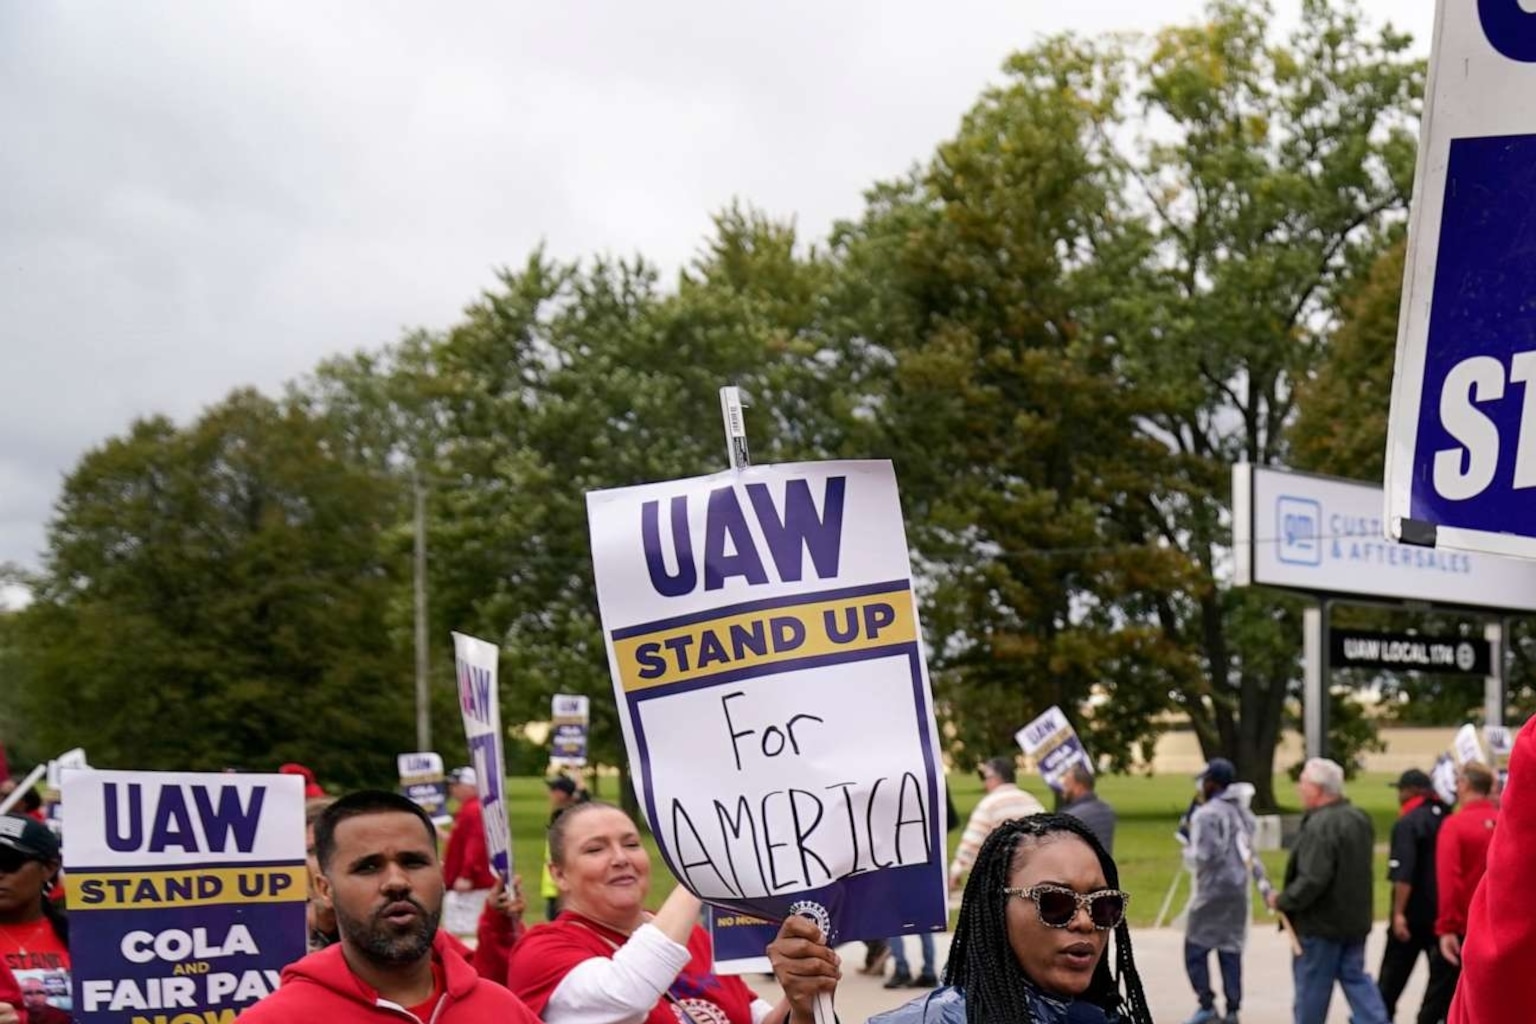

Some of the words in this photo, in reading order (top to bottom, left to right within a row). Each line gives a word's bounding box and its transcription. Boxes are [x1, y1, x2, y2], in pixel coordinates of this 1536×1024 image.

[641, 476, 846, 597] UAW
[1331, 514, 1385, 535] CUST
[1351, 543, 1470, 573] AFTERSALES
[636, 616, 805, 679] STAND
[824, 602, 895, 644] UP
[1381, 641, 1430, 664] LOCAL
[722, 692, 823, 770] For
[103, 782, 266, 853] UAW
[673, 773, 931, 898] AMERICA
[80, 875, 223, 903] STAND
[239, 873, 292, 898] UP
[717, 917, 734, 927] NO
[120, 924, 259, 964] COLA
[173, 962, 210, 975] AND
[82, 977, 194, 1012] FAIR
